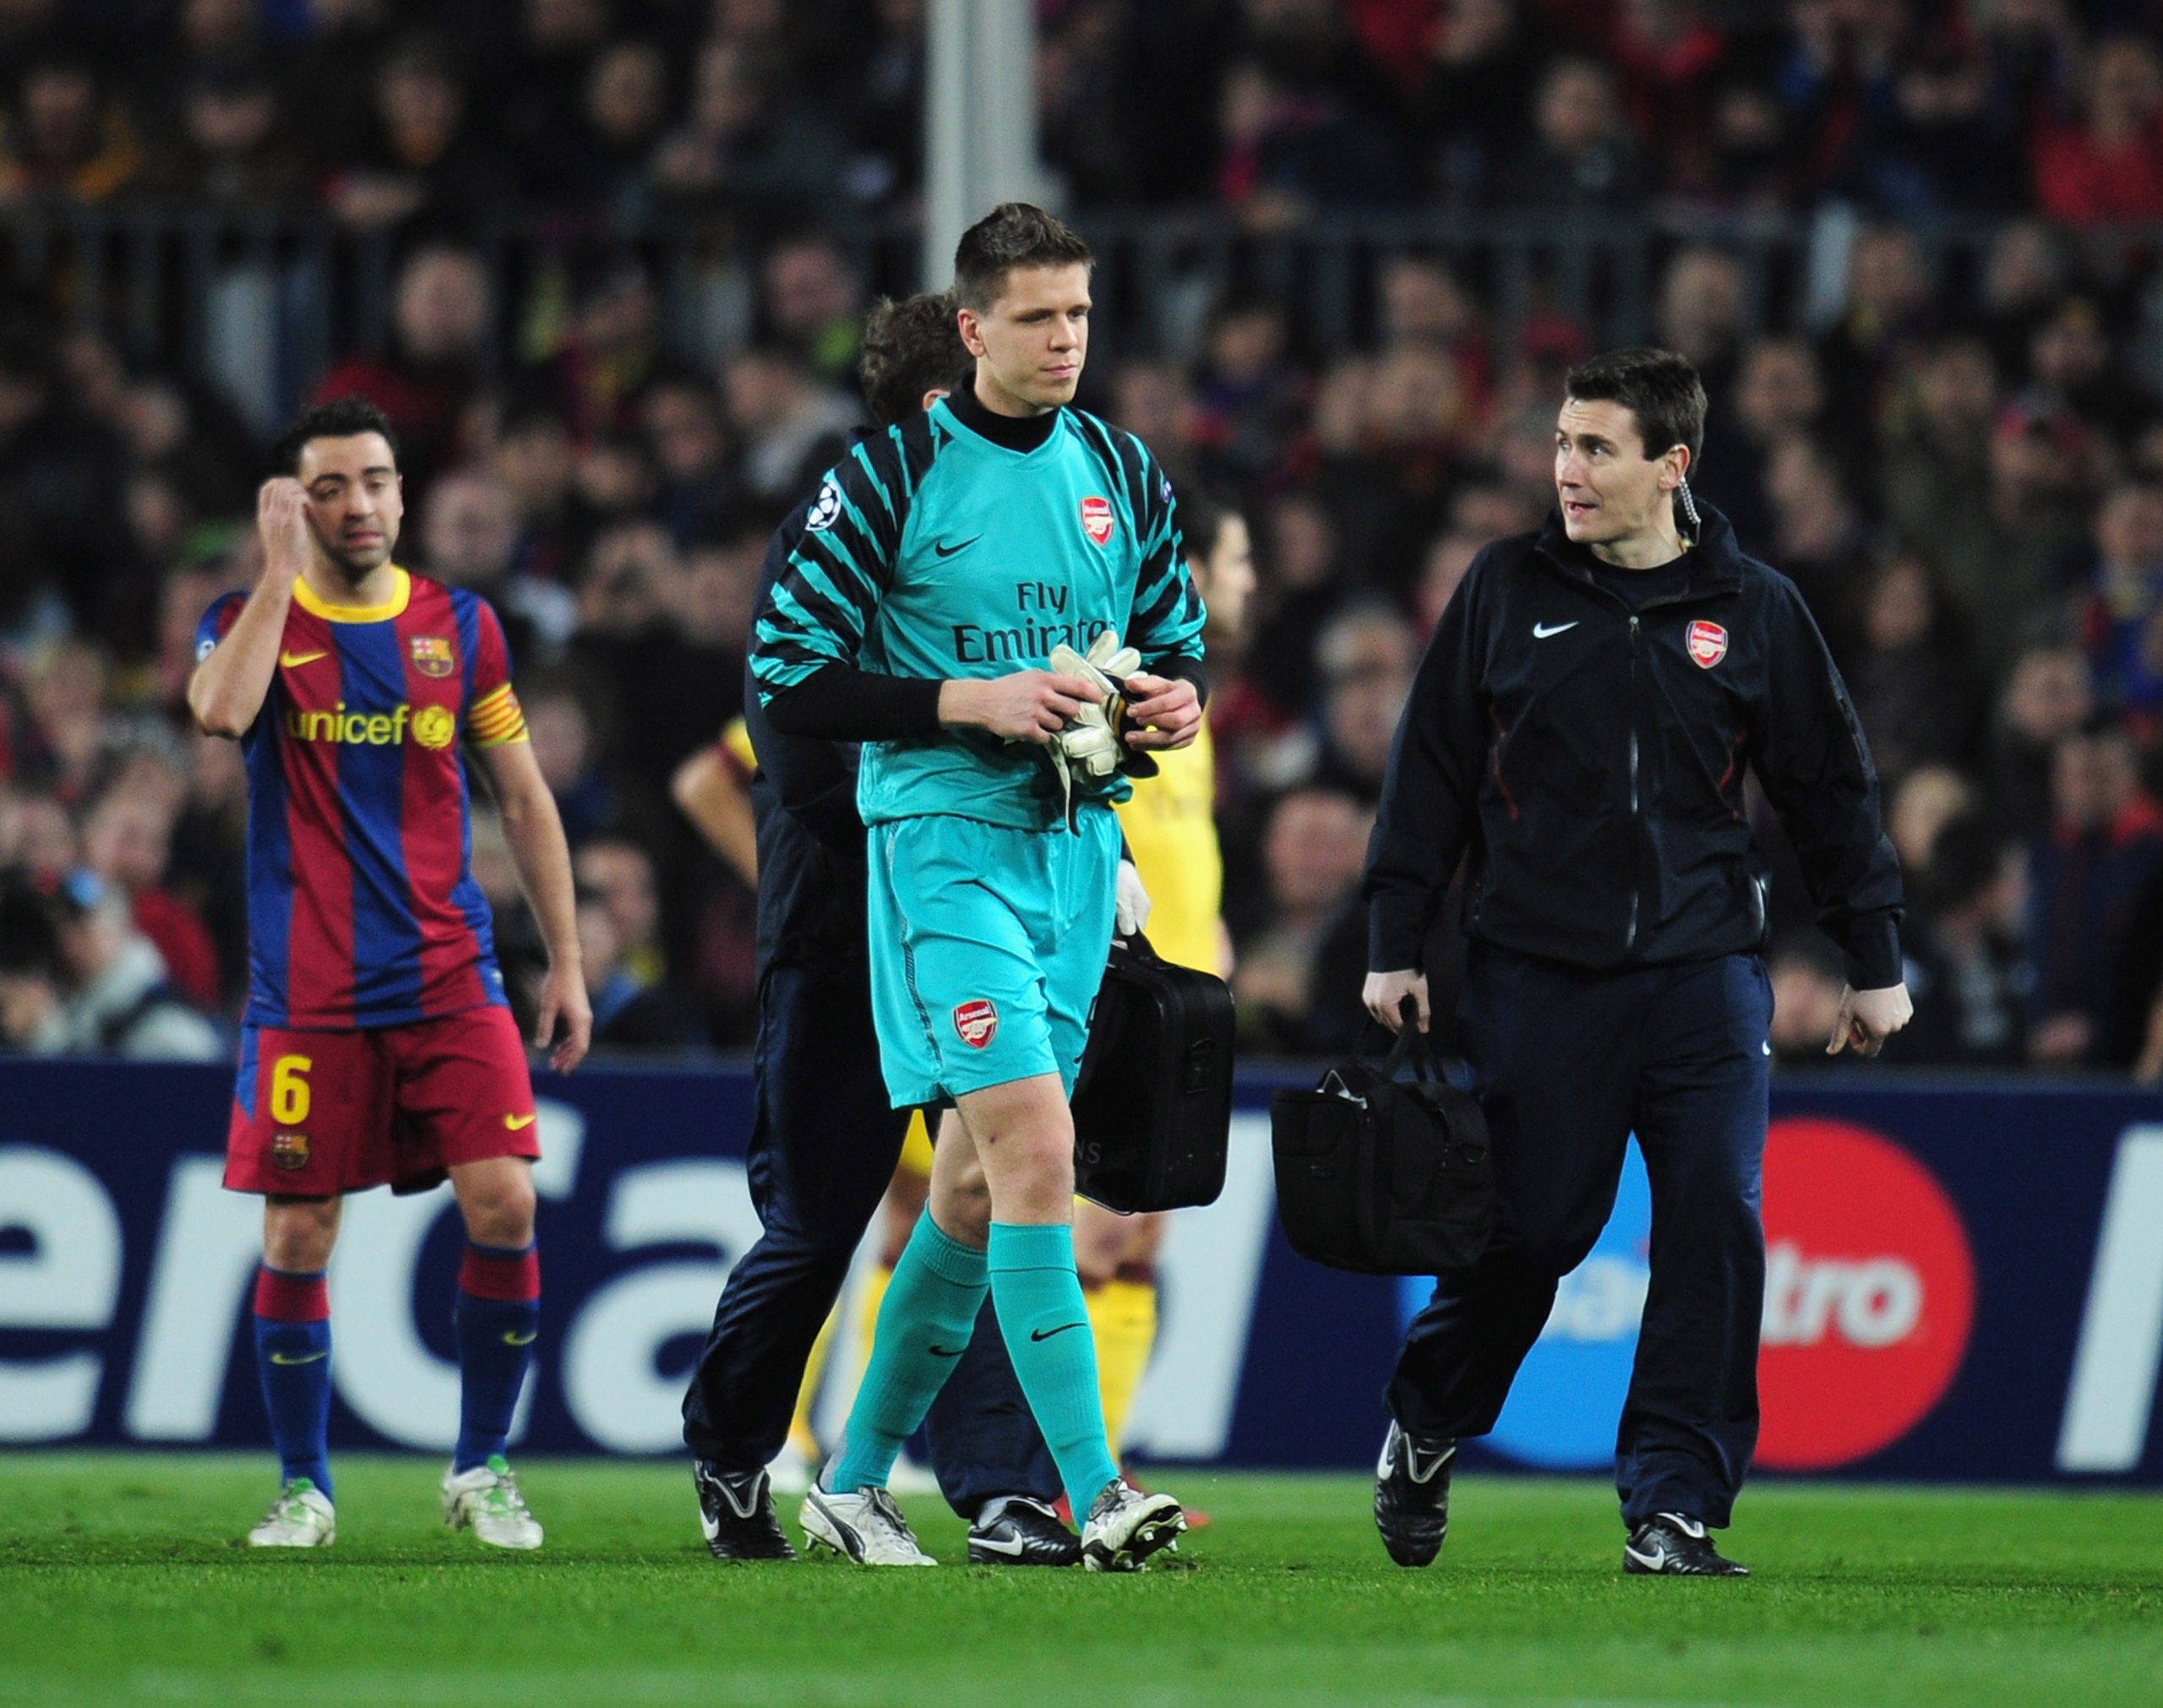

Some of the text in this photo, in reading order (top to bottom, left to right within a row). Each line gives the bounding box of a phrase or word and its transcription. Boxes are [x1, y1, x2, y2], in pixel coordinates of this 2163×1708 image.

[1016, 581, 1068, 615] Fly
[951, 617, 1117, 663] Emirate
[287, 700, 411, 746] unicef
[270, 1053, 313, 1126] 6
